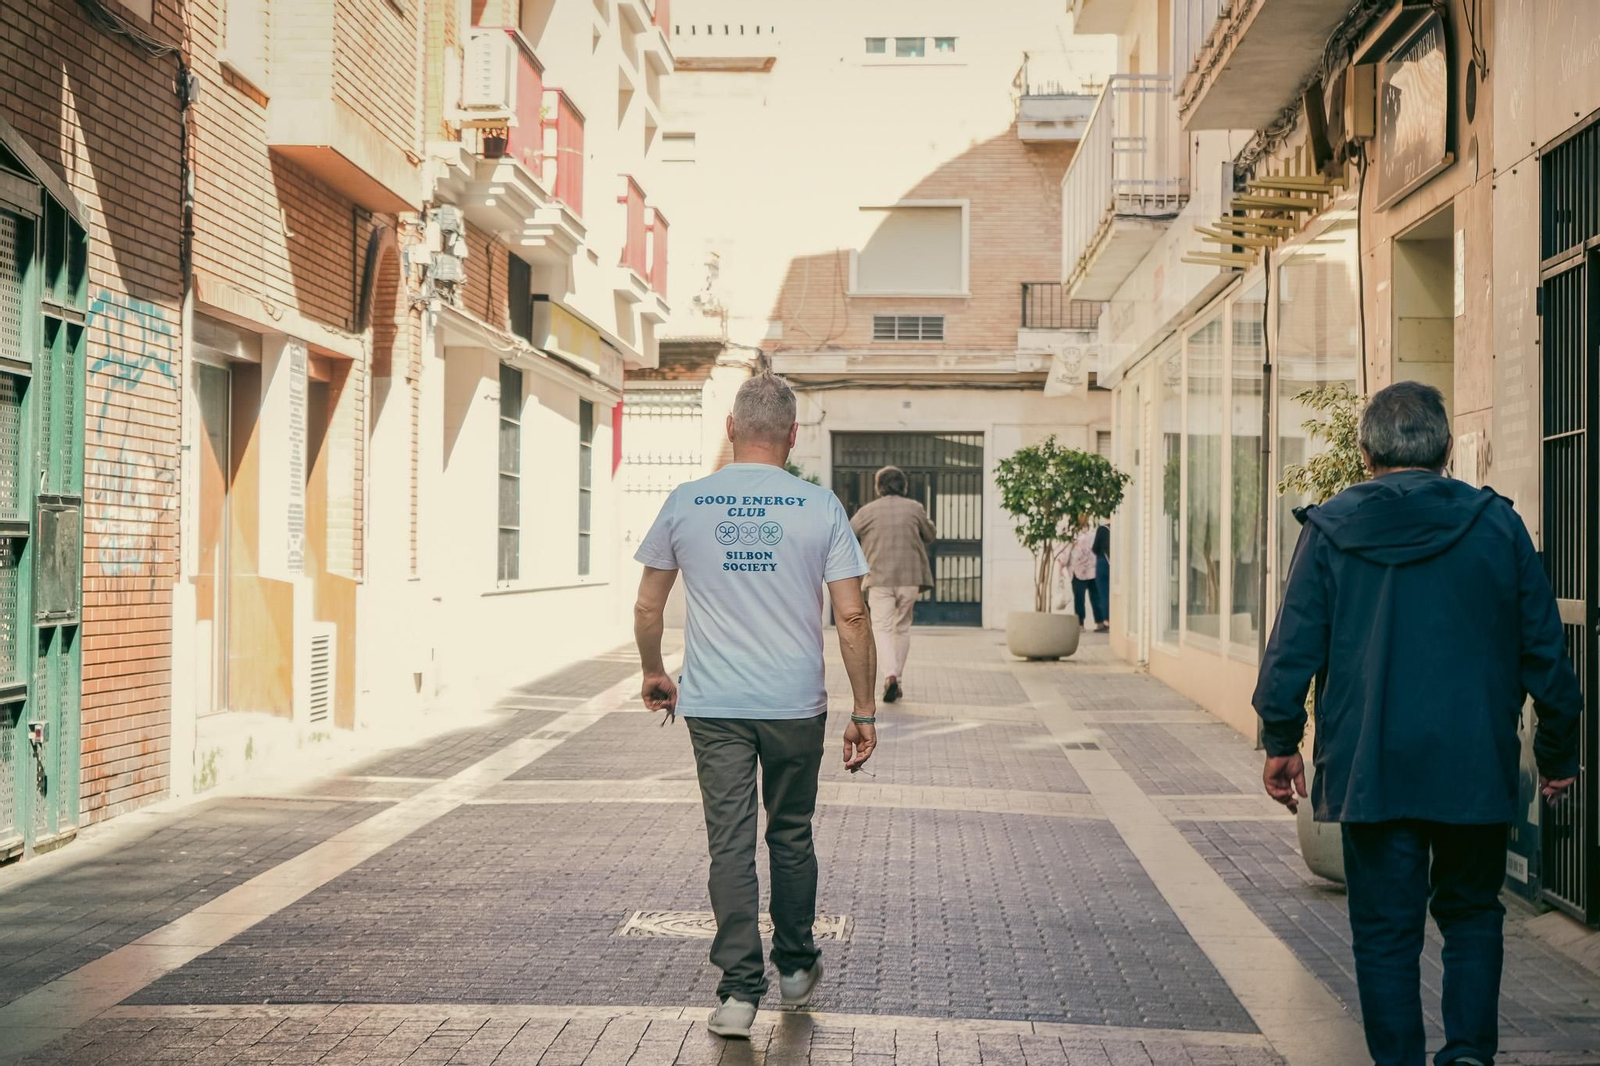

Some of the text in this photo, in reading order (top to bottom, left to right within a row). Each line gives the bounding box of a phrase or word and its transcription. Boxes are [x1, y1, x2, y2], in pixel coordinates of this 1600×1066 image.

[694, 495, 807, 507] GOOD ENERGY
[727, 507, 766, 517] CLUB
[725, 551, 773, 560] SILBON
[722, 562, 777, 572] SOCIETY
